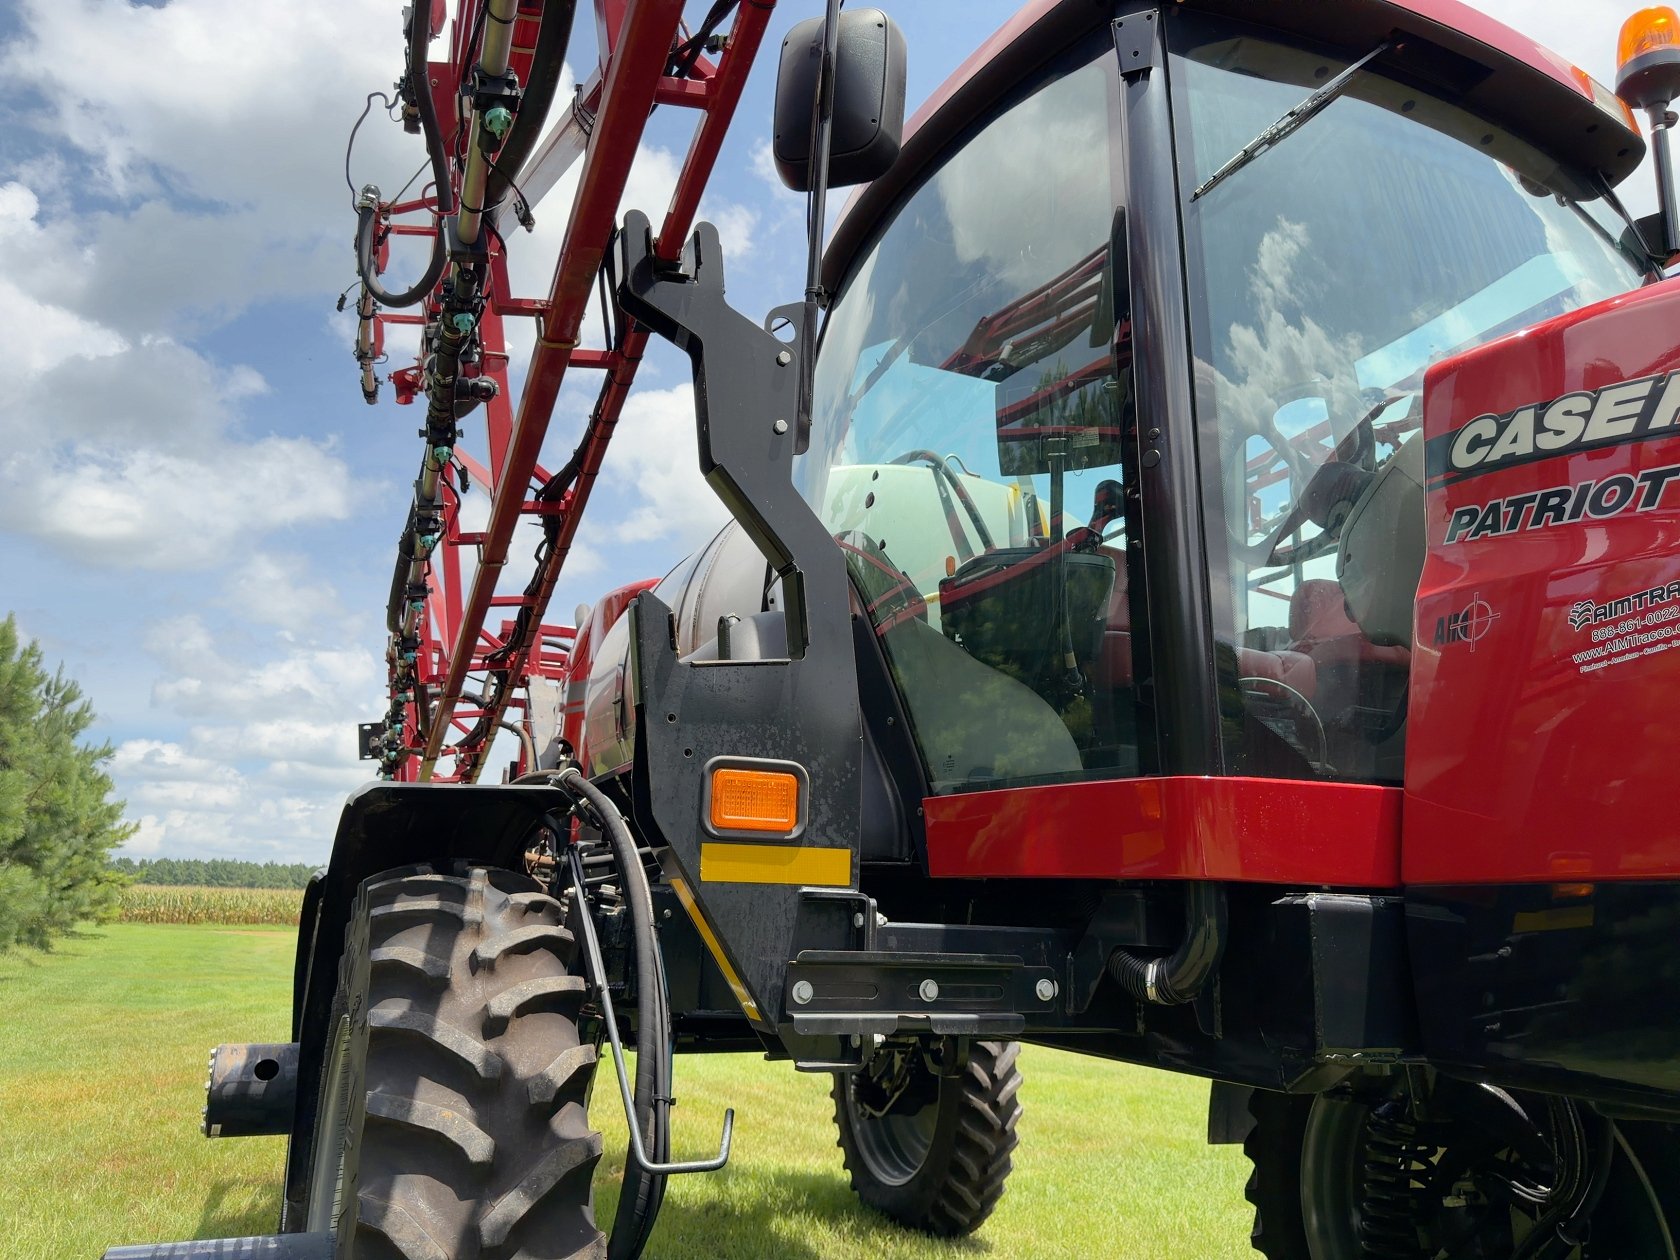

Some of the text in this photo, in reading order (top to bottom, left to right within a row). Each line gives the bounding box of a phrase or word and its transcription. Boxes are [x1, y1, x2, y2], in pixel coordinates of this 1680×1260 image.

[1443, 464, 1680, 545] PATRIOT
[1433, 609, 1469, 646] AIM
[1592, 605, 1680, 642] 888-861-0022
